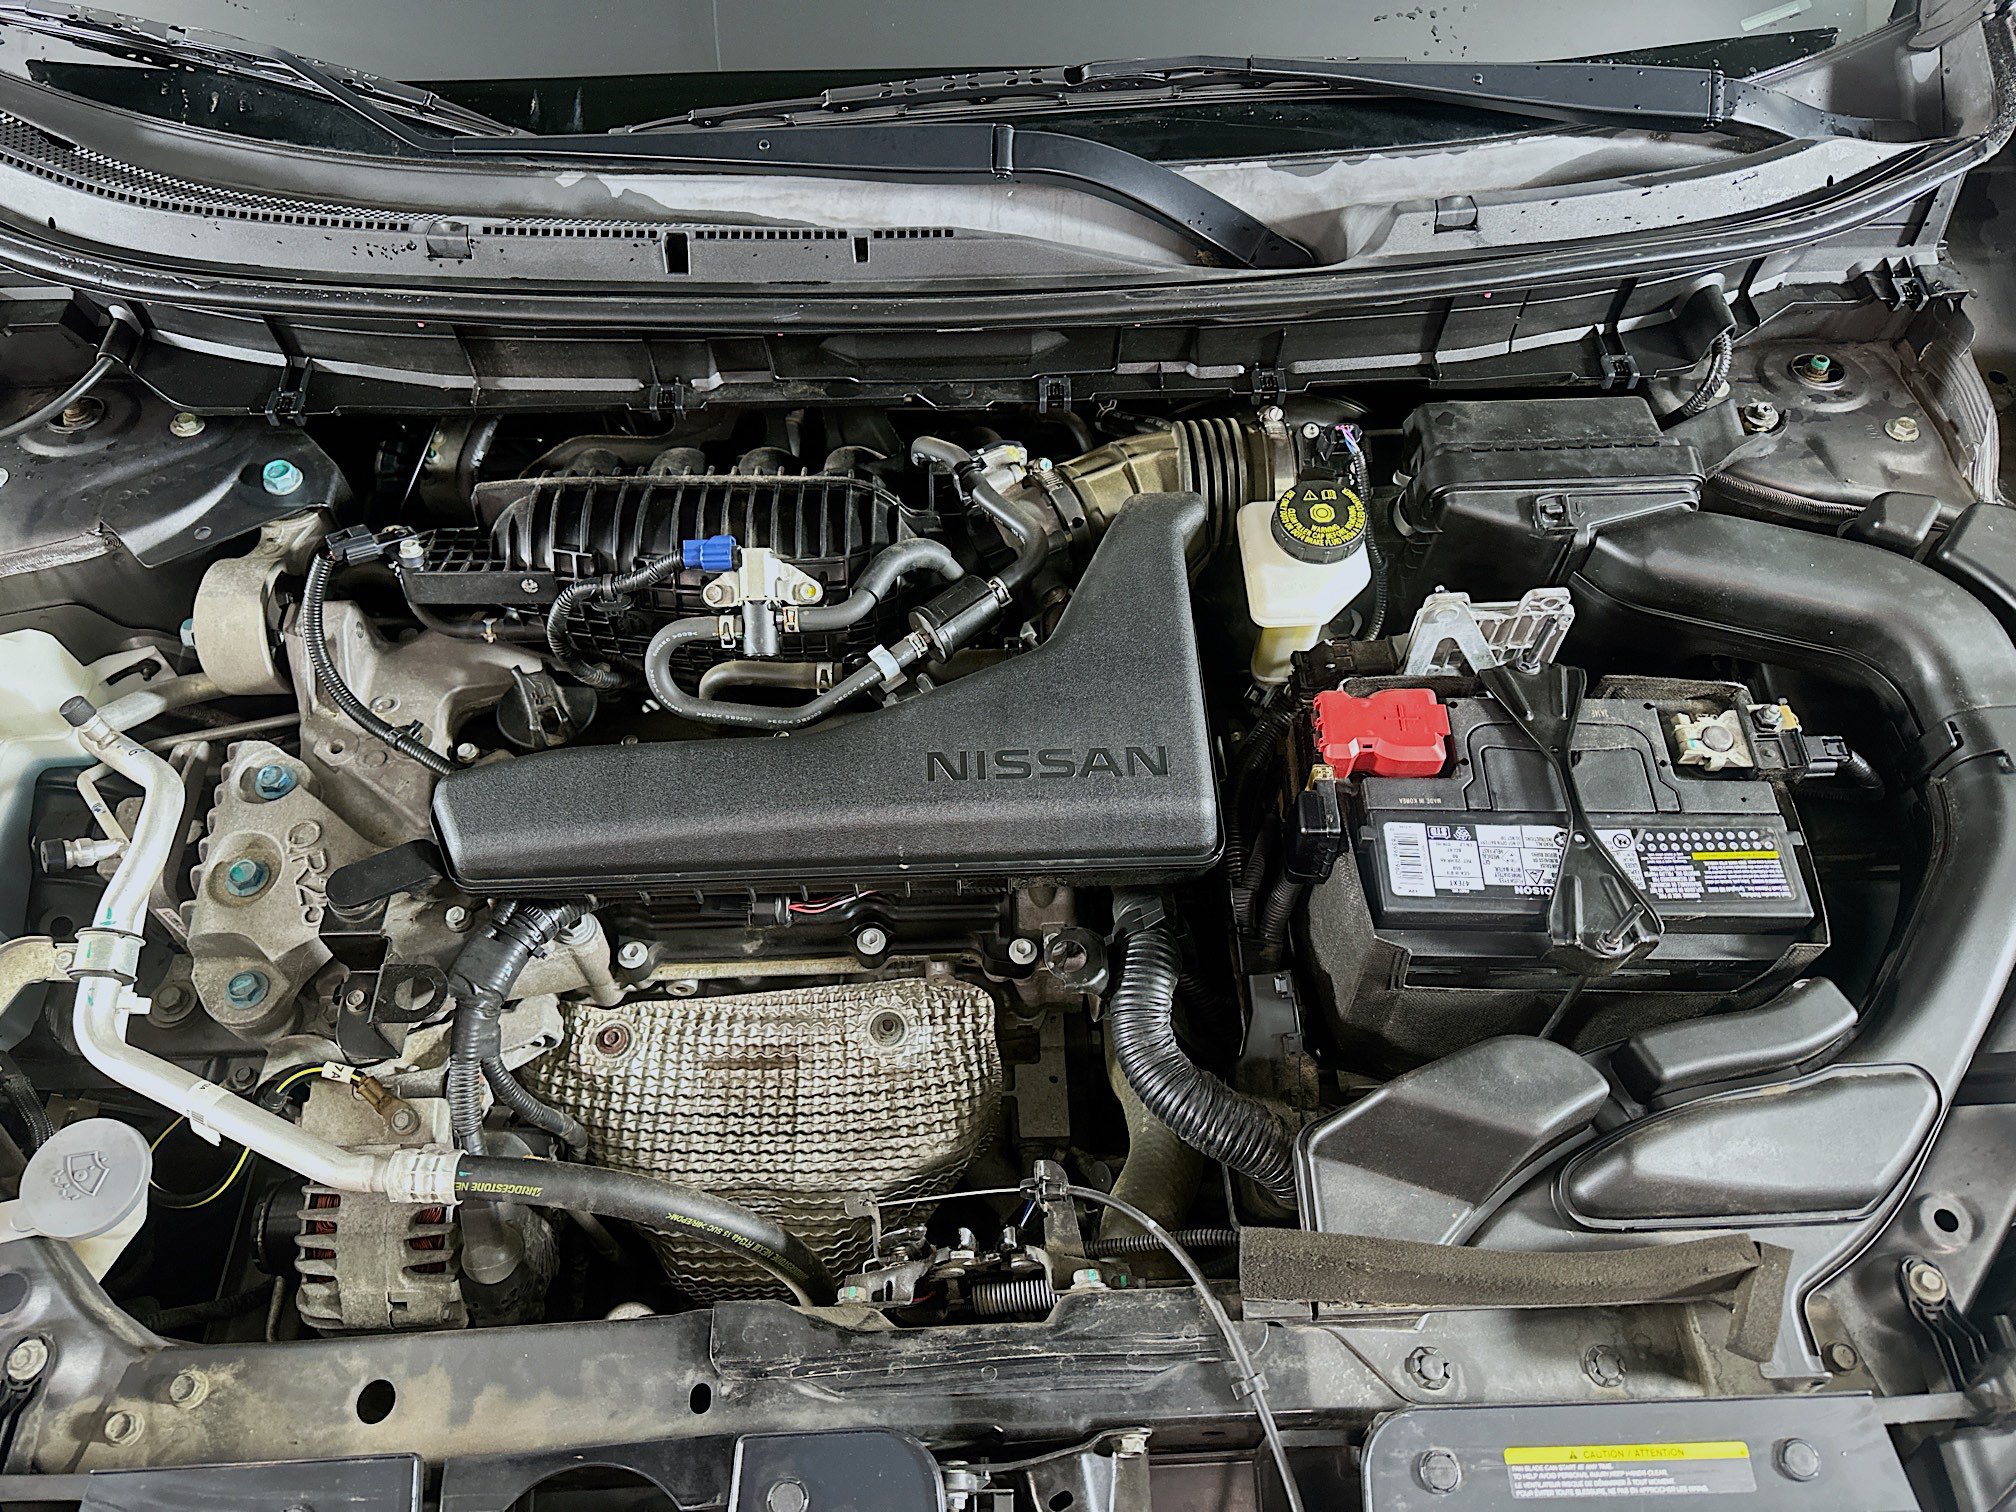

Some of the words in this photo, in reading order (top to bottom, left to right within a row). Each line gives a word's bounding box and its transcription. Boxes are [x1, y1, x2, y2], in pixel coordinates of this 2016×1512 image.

[1294, 522, 1312, 536] FILLER
[1312, 532, 1324, 540] CAP
[1326, 527, 1348, 540] BEFORE
[1310, 524, 1340, 534] WARNING
[1304, 536, 1324, 546] BRAKE
[1325, 538, 1342, 546] FLUID
[925, 746, 1169, 783] NISSAN
[1514, 886, 1553, 896] OISON
[332, 1065, 344, 1079] 7A
[455, 1182, 469, 1191] NE
[471, 1182, 543, 1197] BRIDGESTONE
[707, 1224, 724, 1236] SUC
[1583, 1450, 1624, 1459] CAUTION
[1635, 1448, 1684, 1457] ATTENTION
[1524, 1464, 1544, 1472] BLADE
[1539, 1472, 1557, 1480] AVOID
